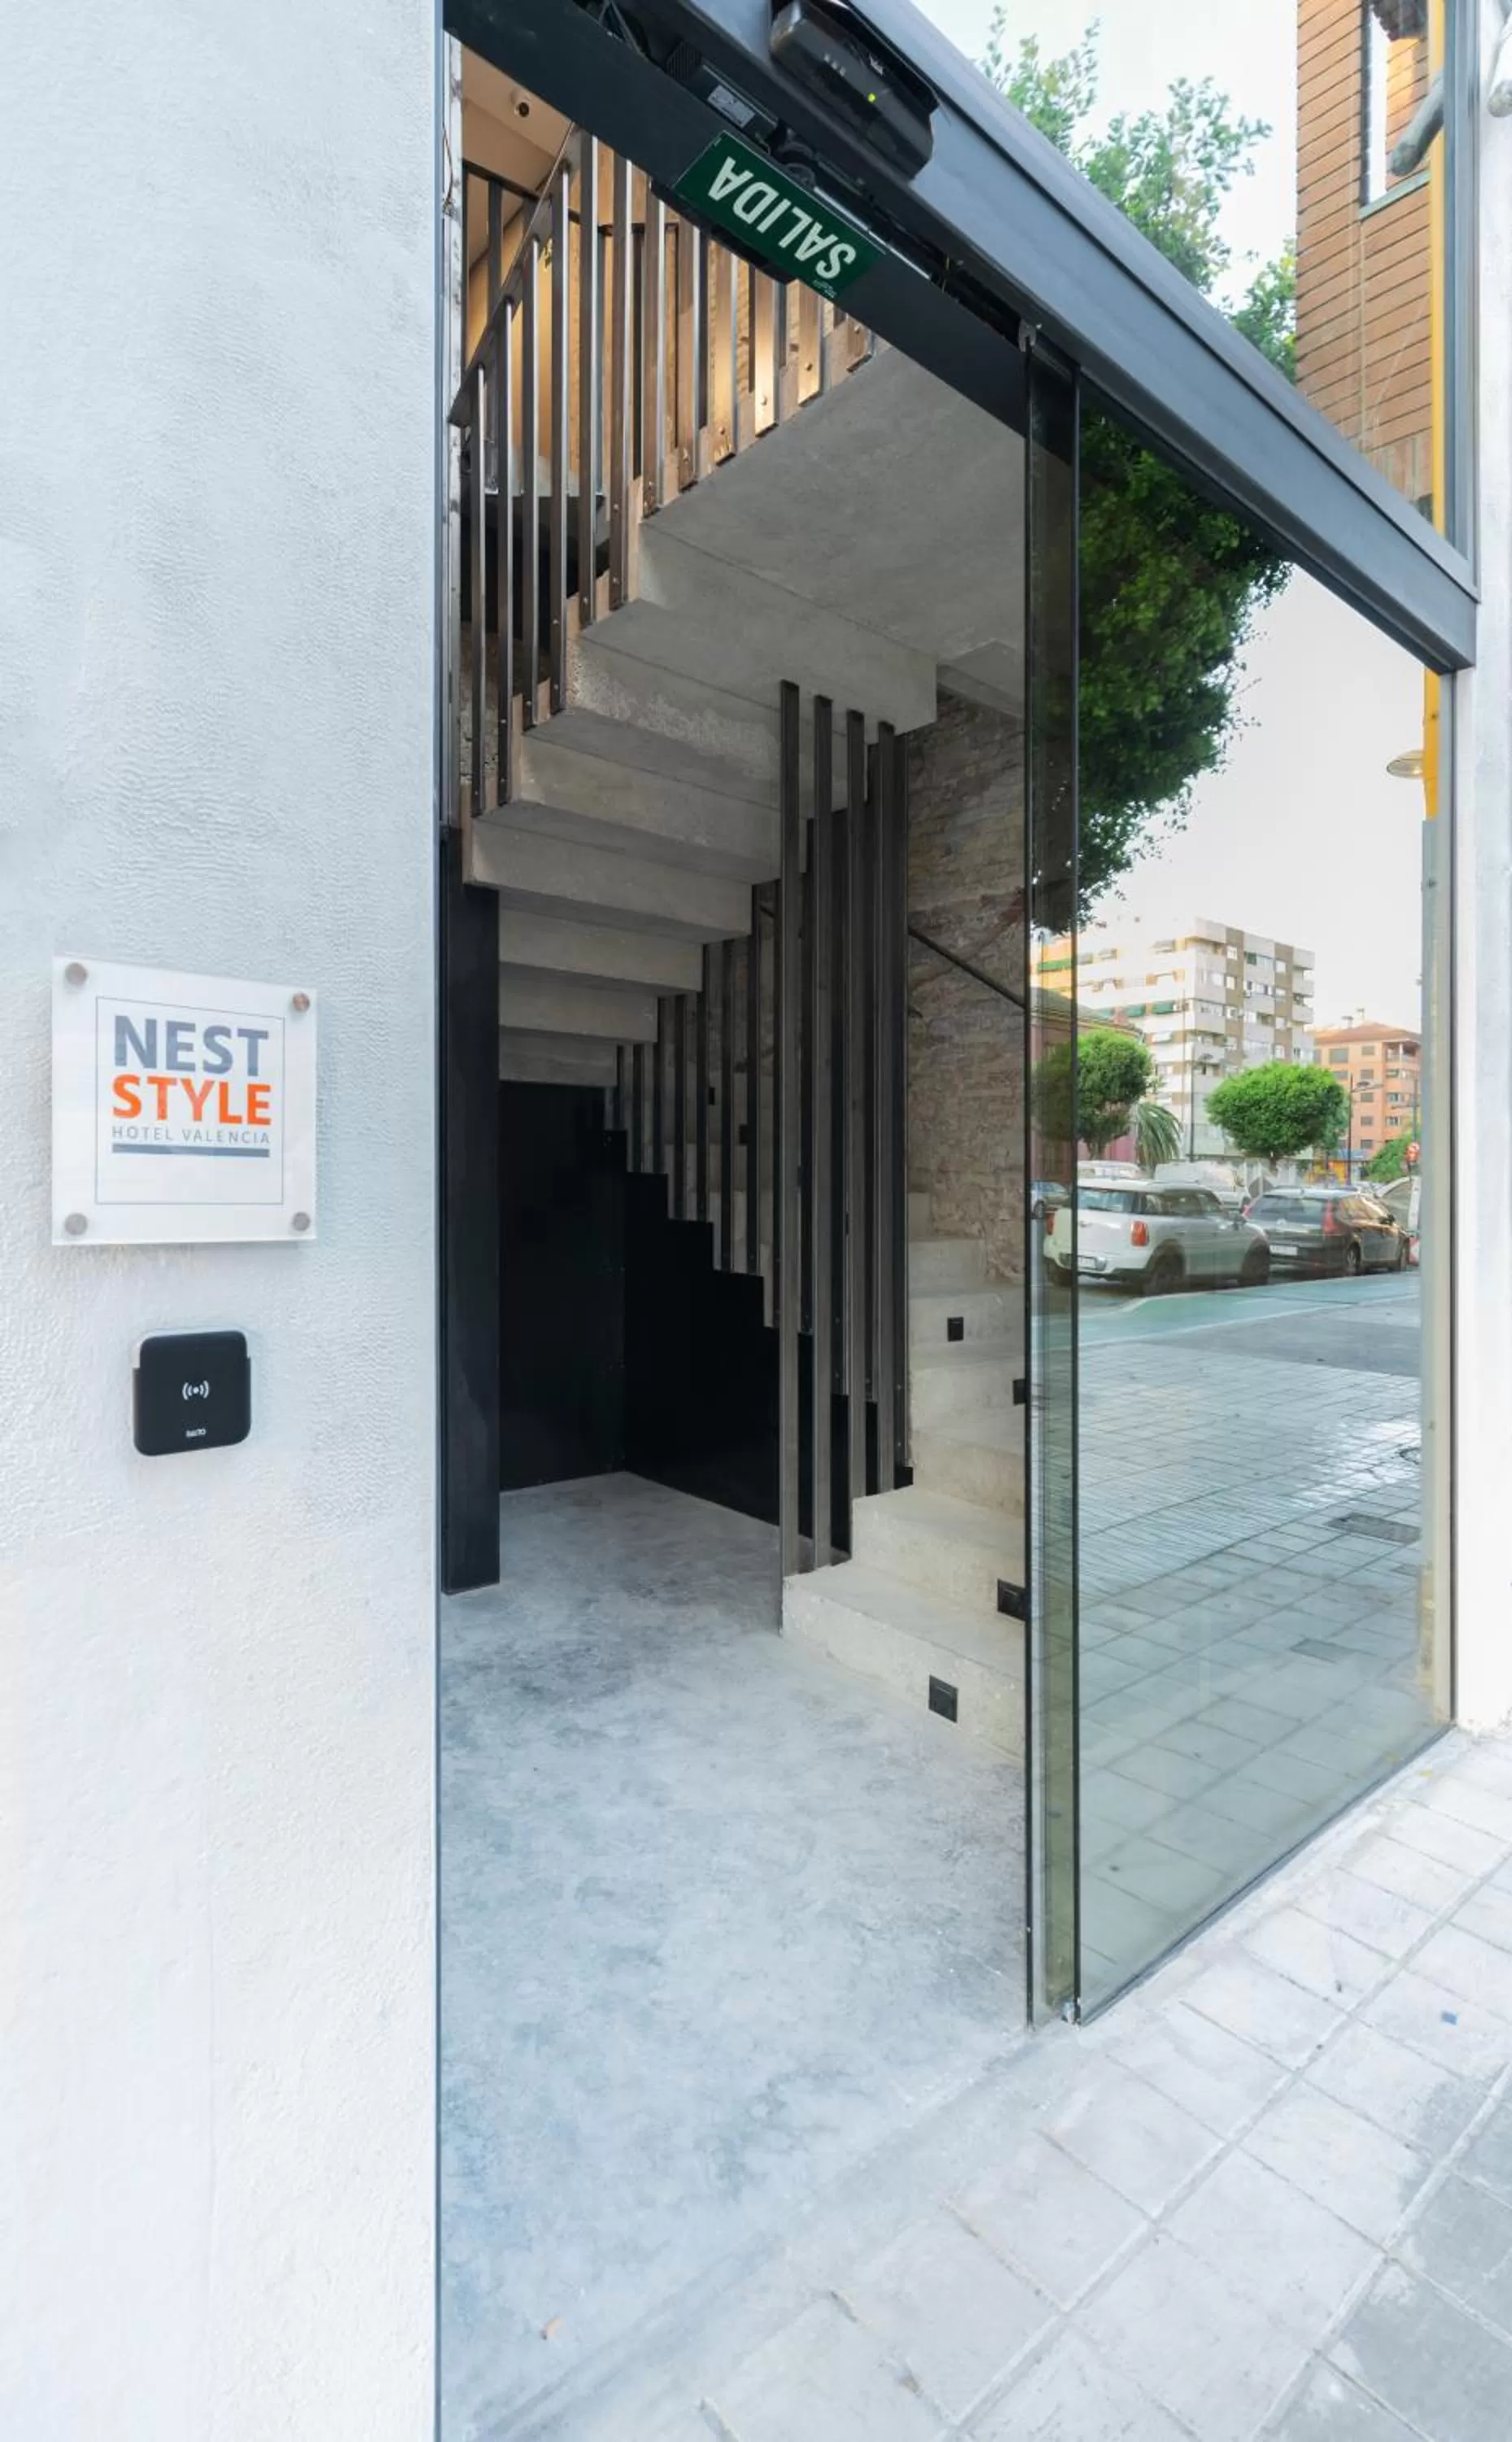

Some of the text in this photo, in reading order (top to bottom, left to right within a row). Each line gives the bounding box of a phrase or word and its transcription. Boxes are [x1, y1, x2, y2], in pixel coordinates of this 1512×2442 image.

[708, 156, 857, 279] SALIDA
[114, 1015, 269, 1077] NEST
[111, 1074, 273, 1127] STYLE
[112, 1126, 271, 1144] HOTEL VALENCIA
